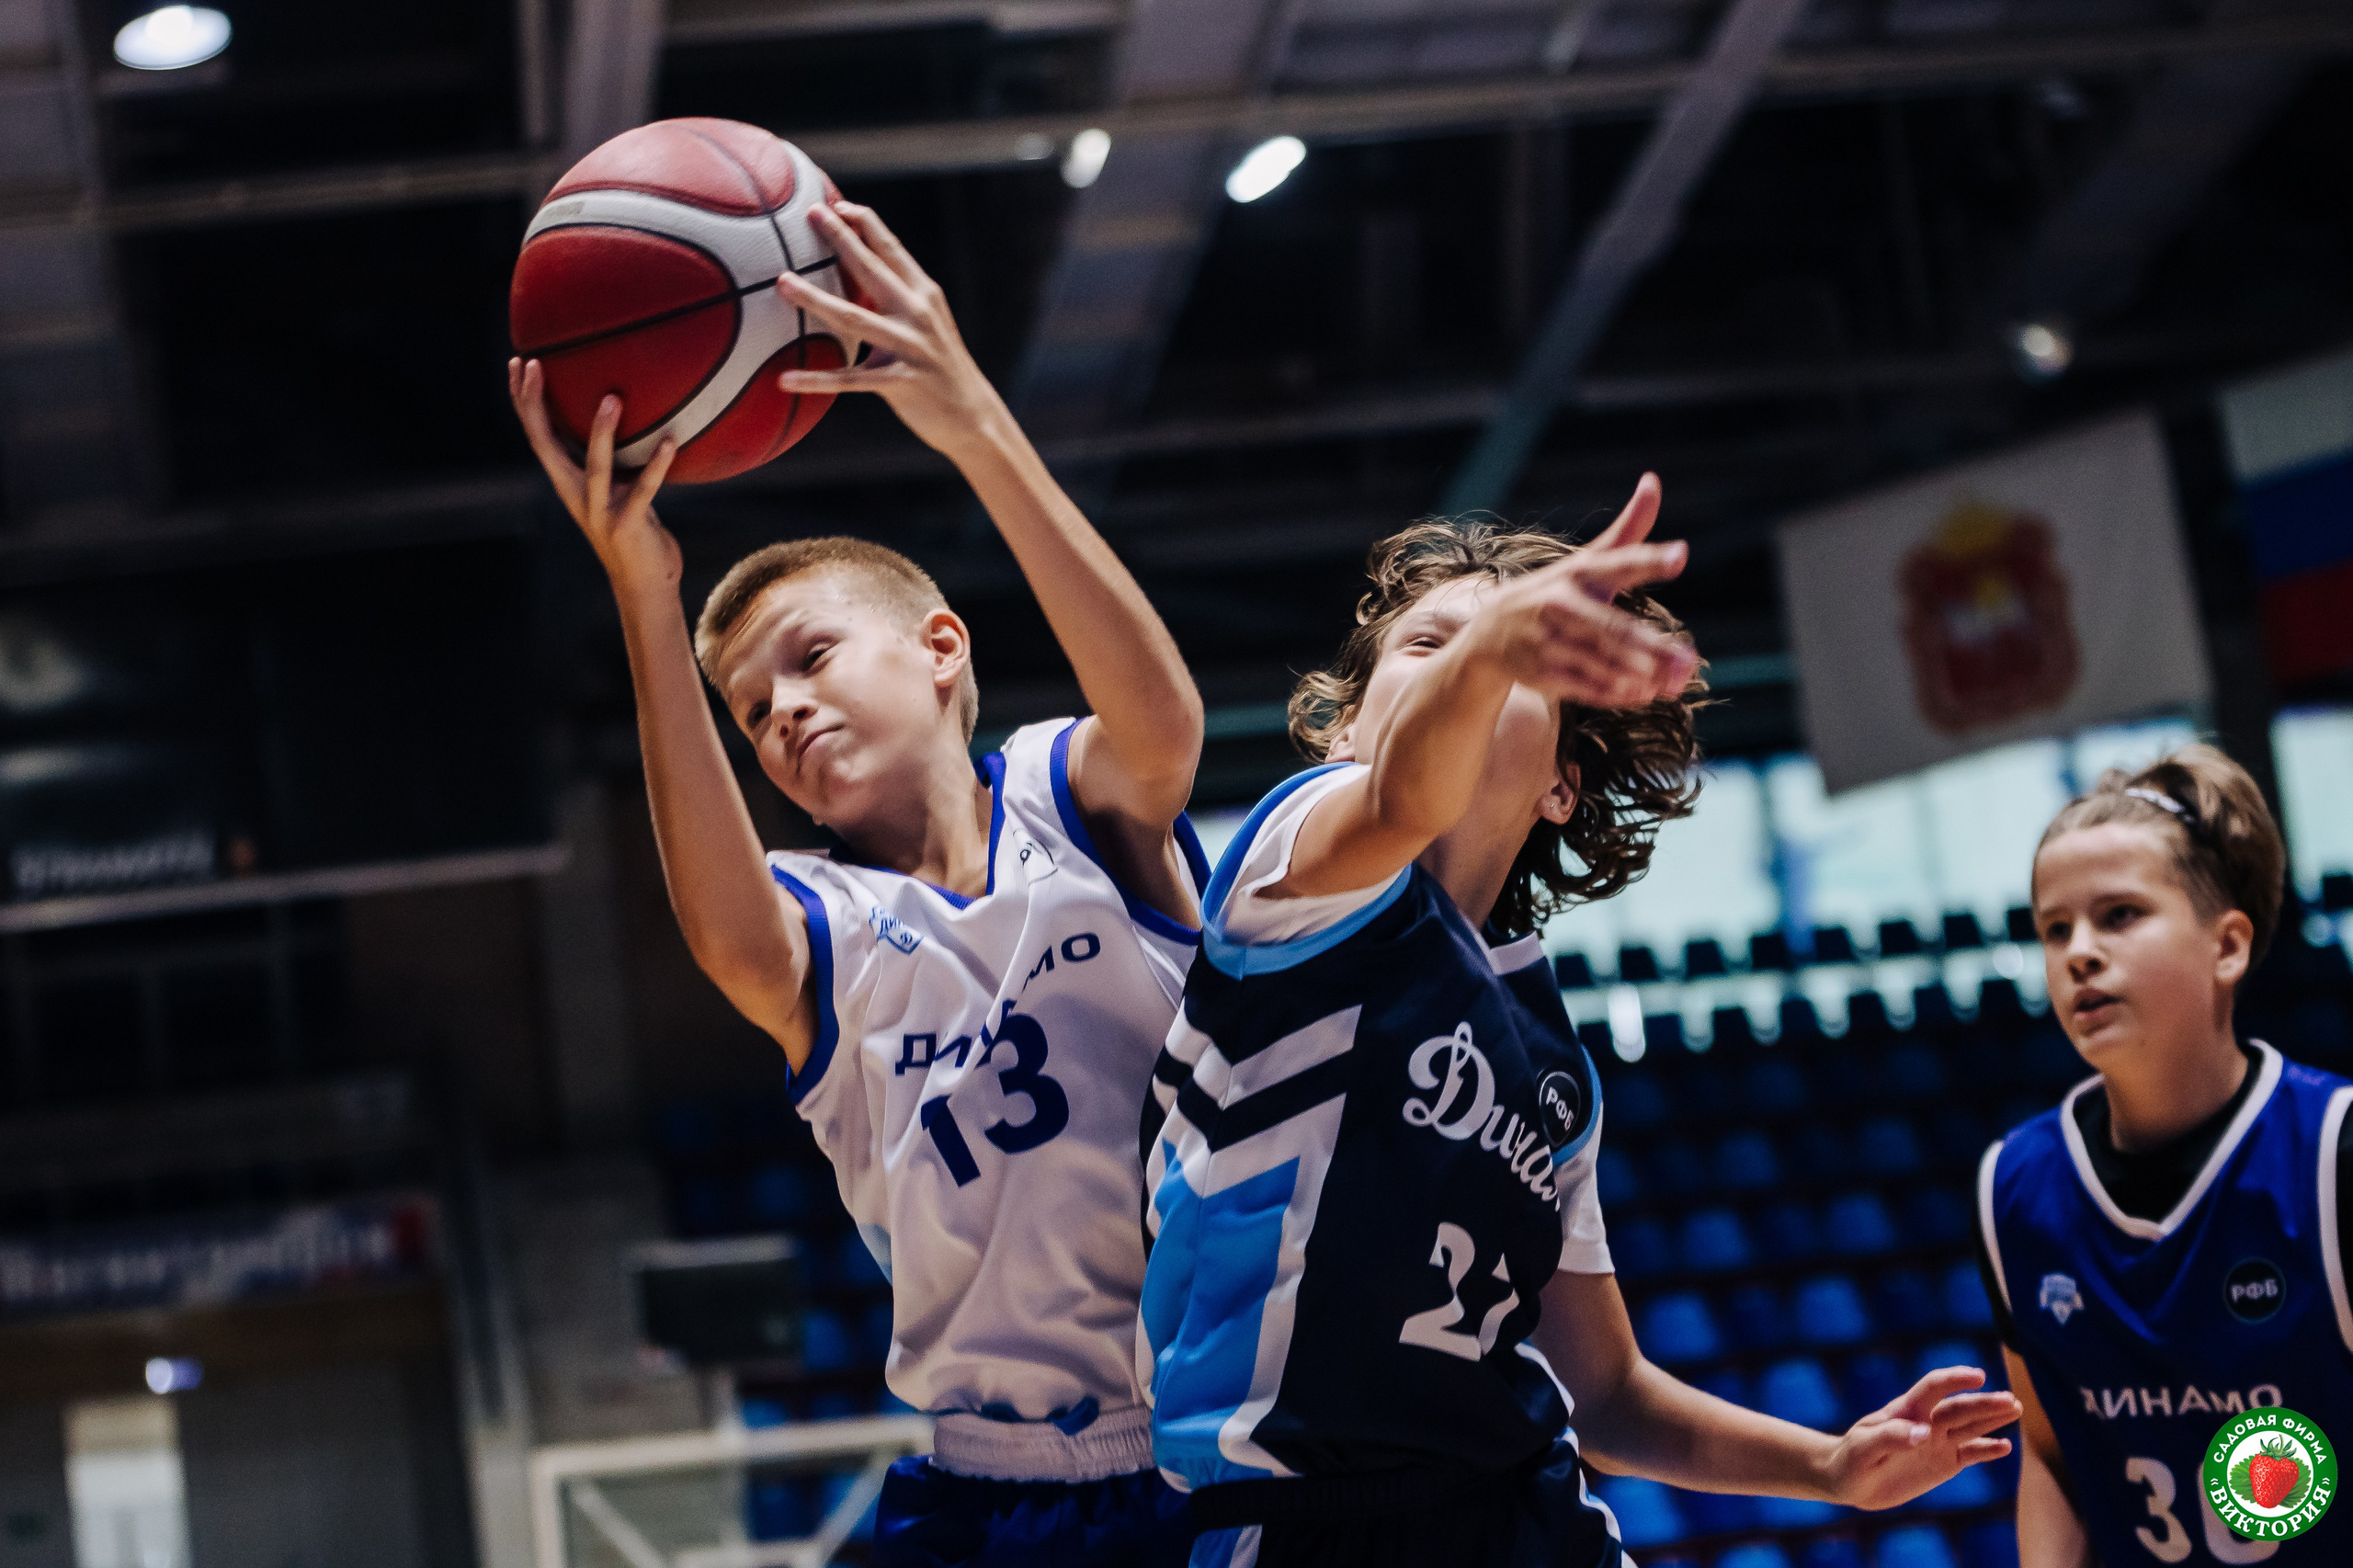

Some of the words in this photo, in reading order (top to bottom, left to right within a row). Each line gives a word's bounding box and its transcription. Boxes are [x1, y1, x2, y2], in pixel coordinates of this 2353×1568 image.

[921, 1014, 1069, 1188] 13
[1402, 1021, 1561, 1212] Дина
[1545, 1086, 1574, 1131] РФБ
[2230, 1278, 2279, 1302] РФБ
